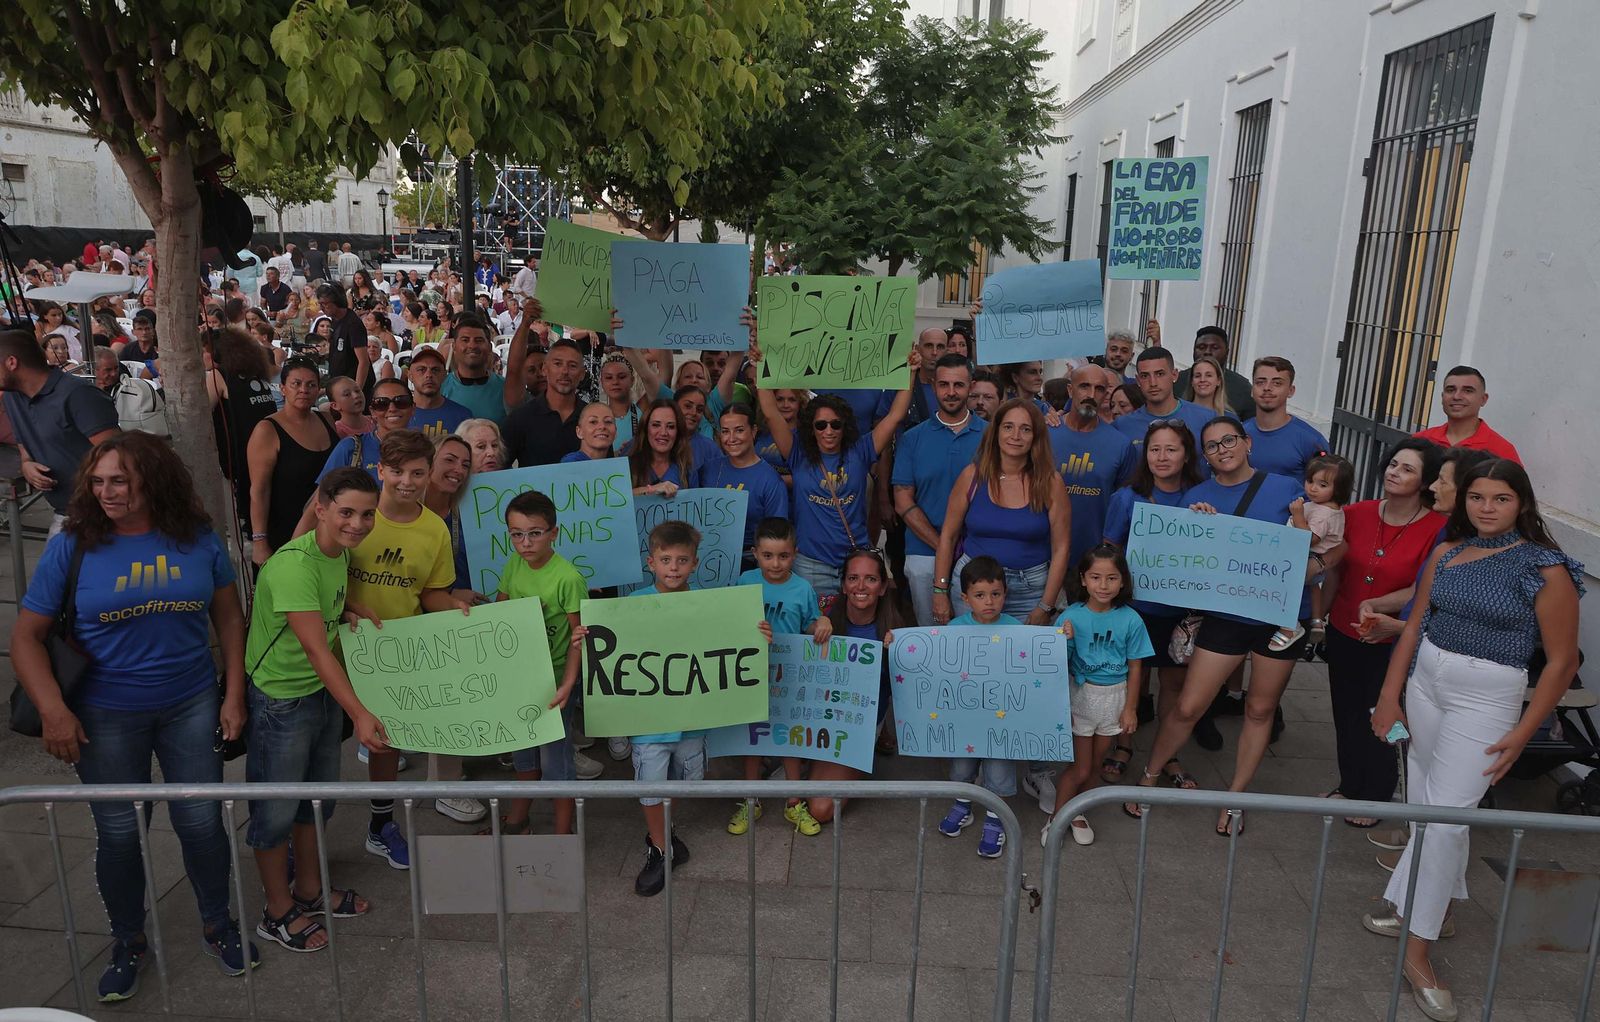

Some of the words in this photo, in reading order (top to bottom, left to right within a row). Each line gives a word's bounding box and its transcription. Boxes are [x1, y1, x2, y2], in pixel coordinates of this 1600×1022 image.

[1115, 186, 1140, 201] DEL
[1116, 162, 1142, 179] LA
[1145, 162, 1196, 192] ERA
[1115, 199, 1199, 226] FRAUDE
[633, 257, 704, 294] PAGA
[658, 302, 698, 336] YA!!
[978, 284, 1103, 342] RESCATE
[473, 482, 535, 529] PO
[551, 474, 627, 512] UNAS
[1130, 547, 1219, 570] NUESTRO
[1227, 558, 1292, 583] DINERO?
[99, 599, 205, 623] socofitness
[1215, 583, 1288, 613] COBRAR!
[586, 625, 760, 697] RESCATE
[803, 636, 876, 665] NIÑOS
[894, 631, 990, 677] QUE
[1004, 634, 1059, 675] LE
[384, 684, 461, 711] VALE
[461, 673, 498, 704] SU
[914, 676, 1027, 712] PAGEN
[748, 722, 849, 759] FERIA?
[901, 721, 919, 753] A
[986, 727, 1074, 762] MADRE
